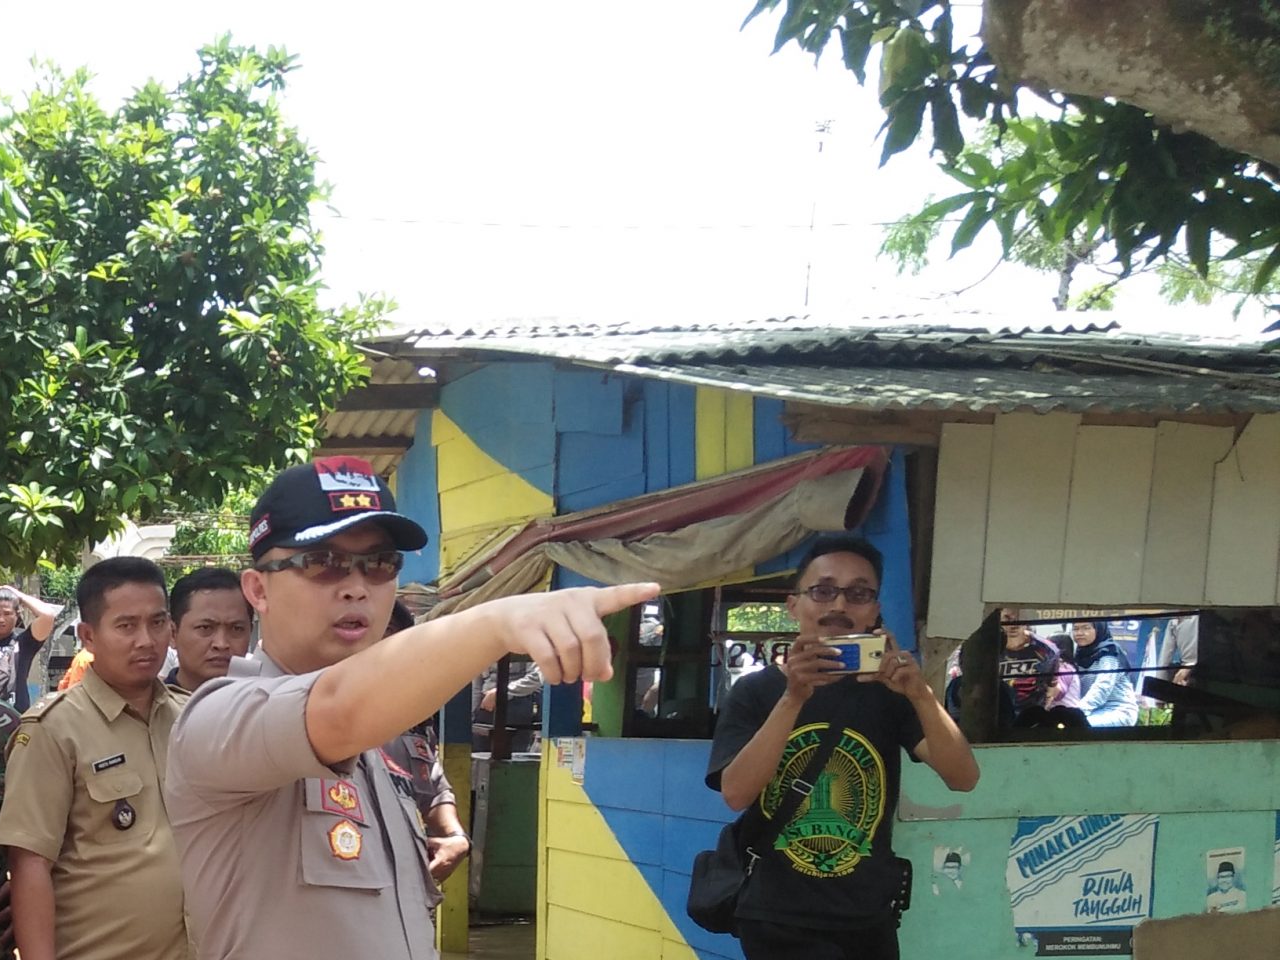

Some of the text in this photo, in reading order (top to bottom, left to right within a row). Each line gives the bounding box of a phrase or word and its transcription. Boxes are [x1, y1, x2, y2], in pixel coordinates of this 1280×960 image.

[837, 734, 873, 770] IJAU
[786, 822, 858, 841] SUBANG
[1016, 832, 1070, 879] MINAK
[1082, 871, 1134, 897] DJIWA
[1073, 894, 1143, 919] TANGGUH
[1045, 943, 1076, 951] MEROKOK
